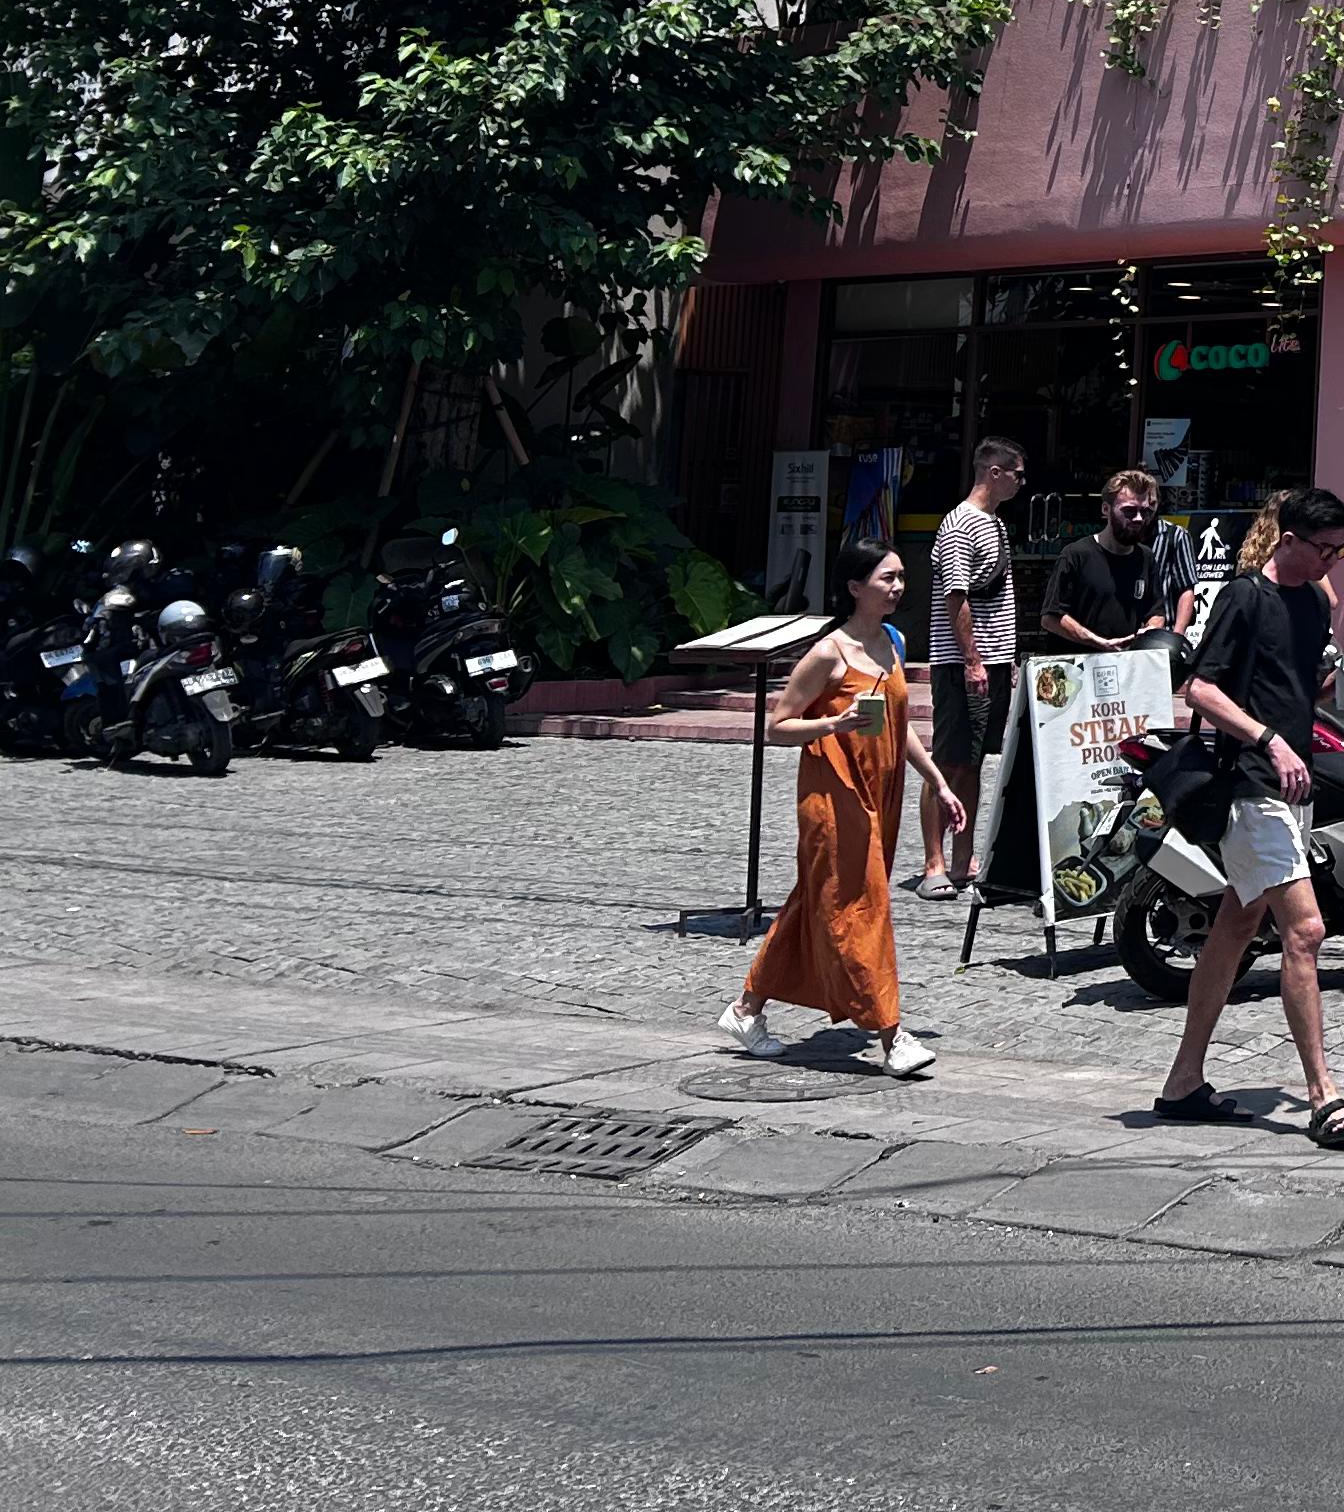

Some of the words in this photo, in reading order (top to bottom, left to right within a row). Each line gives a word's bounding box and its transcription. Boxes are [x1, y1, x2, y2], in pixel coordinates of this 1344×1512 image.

[1090, 700, 1126, 719] KORI
[1069, 714, 1150, 747] STEAK
[1090, 767, 1112, 781] OPEN
